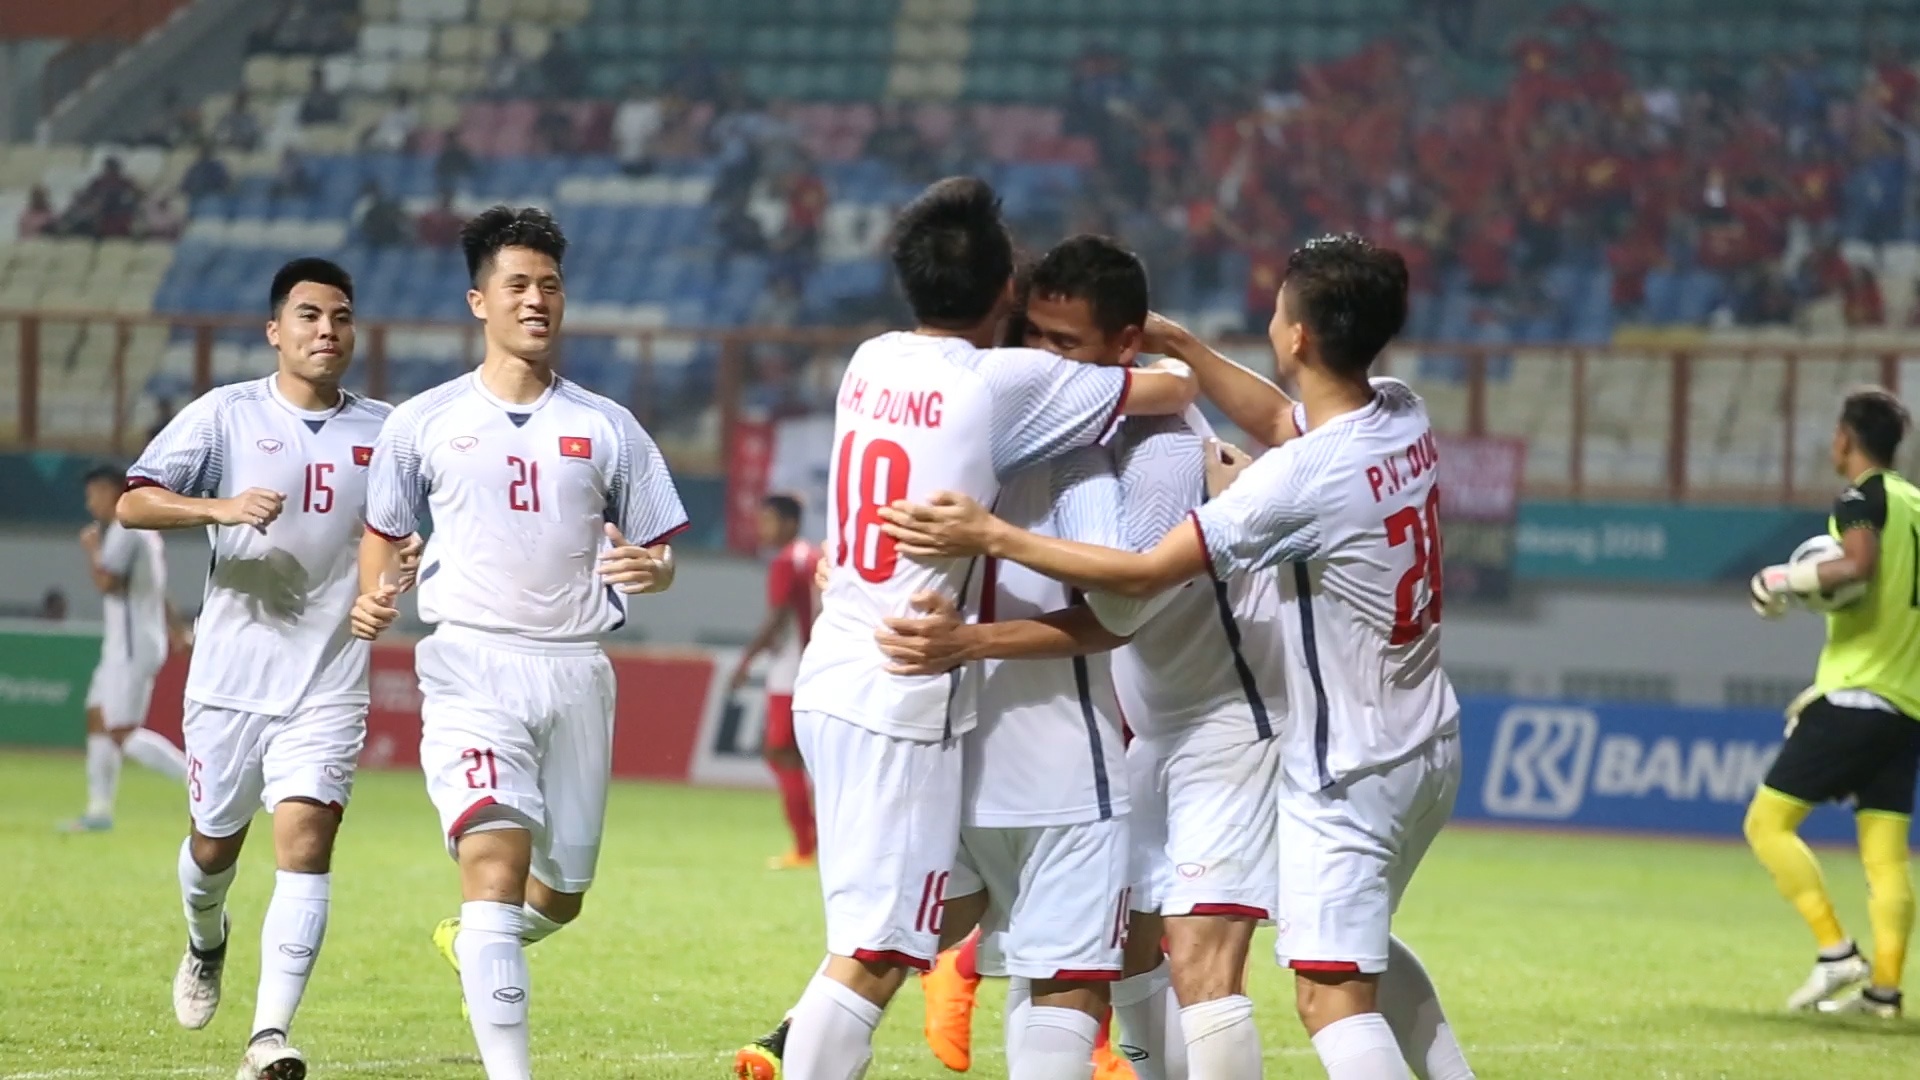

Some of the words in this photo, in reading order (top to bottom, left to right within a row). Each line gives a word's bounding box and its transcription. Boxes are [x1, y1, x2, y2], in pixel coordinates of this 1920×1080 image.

[872, 388, 944, 429] DUNG
[303, 463, 335, 513] 15
[506, 455, 541, 513] 21
[836, 429, 912, 585] 18
[1366, 455, 1407, 503] P.V.
[1383, 483, 1443, 645] 20
[461, 747, 498, 790] 21
[1593, 735, 1784, 803] BANK
[914, 870, 950, 935] 18
